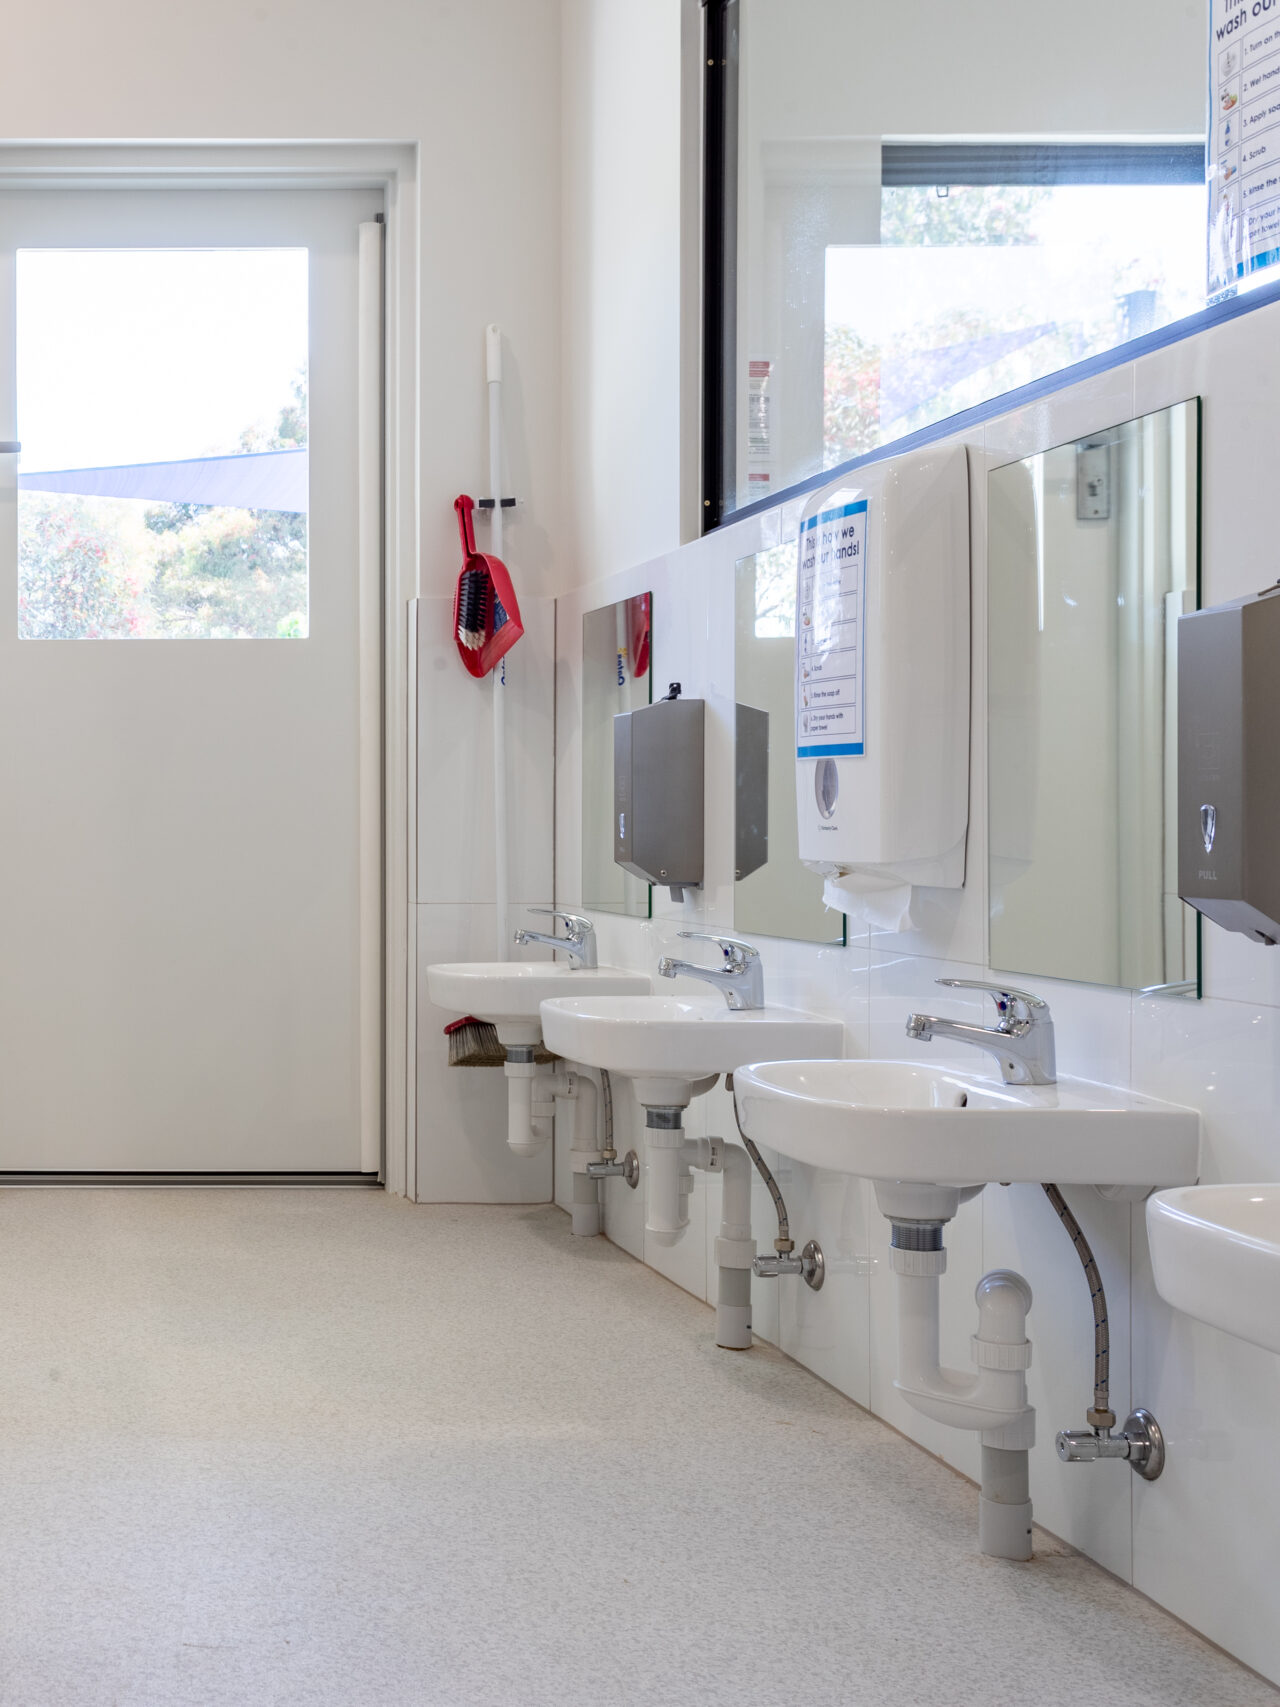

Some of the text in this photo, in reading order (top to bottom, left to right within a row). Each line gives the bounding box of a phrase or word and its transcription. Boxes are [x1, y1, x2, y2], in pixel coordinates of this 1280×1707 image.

[1216, 9, 1247, 42] wash
[1249, 75, 1262, 88] Wet
[1249, 110, 1267, 125] Apply
[1249, 145, 1266, 160] Scrub
[1266, 177, 1277, 187] the
[841, 526, 855, 539] we
[1198, 870, 1217, 880] PULL
